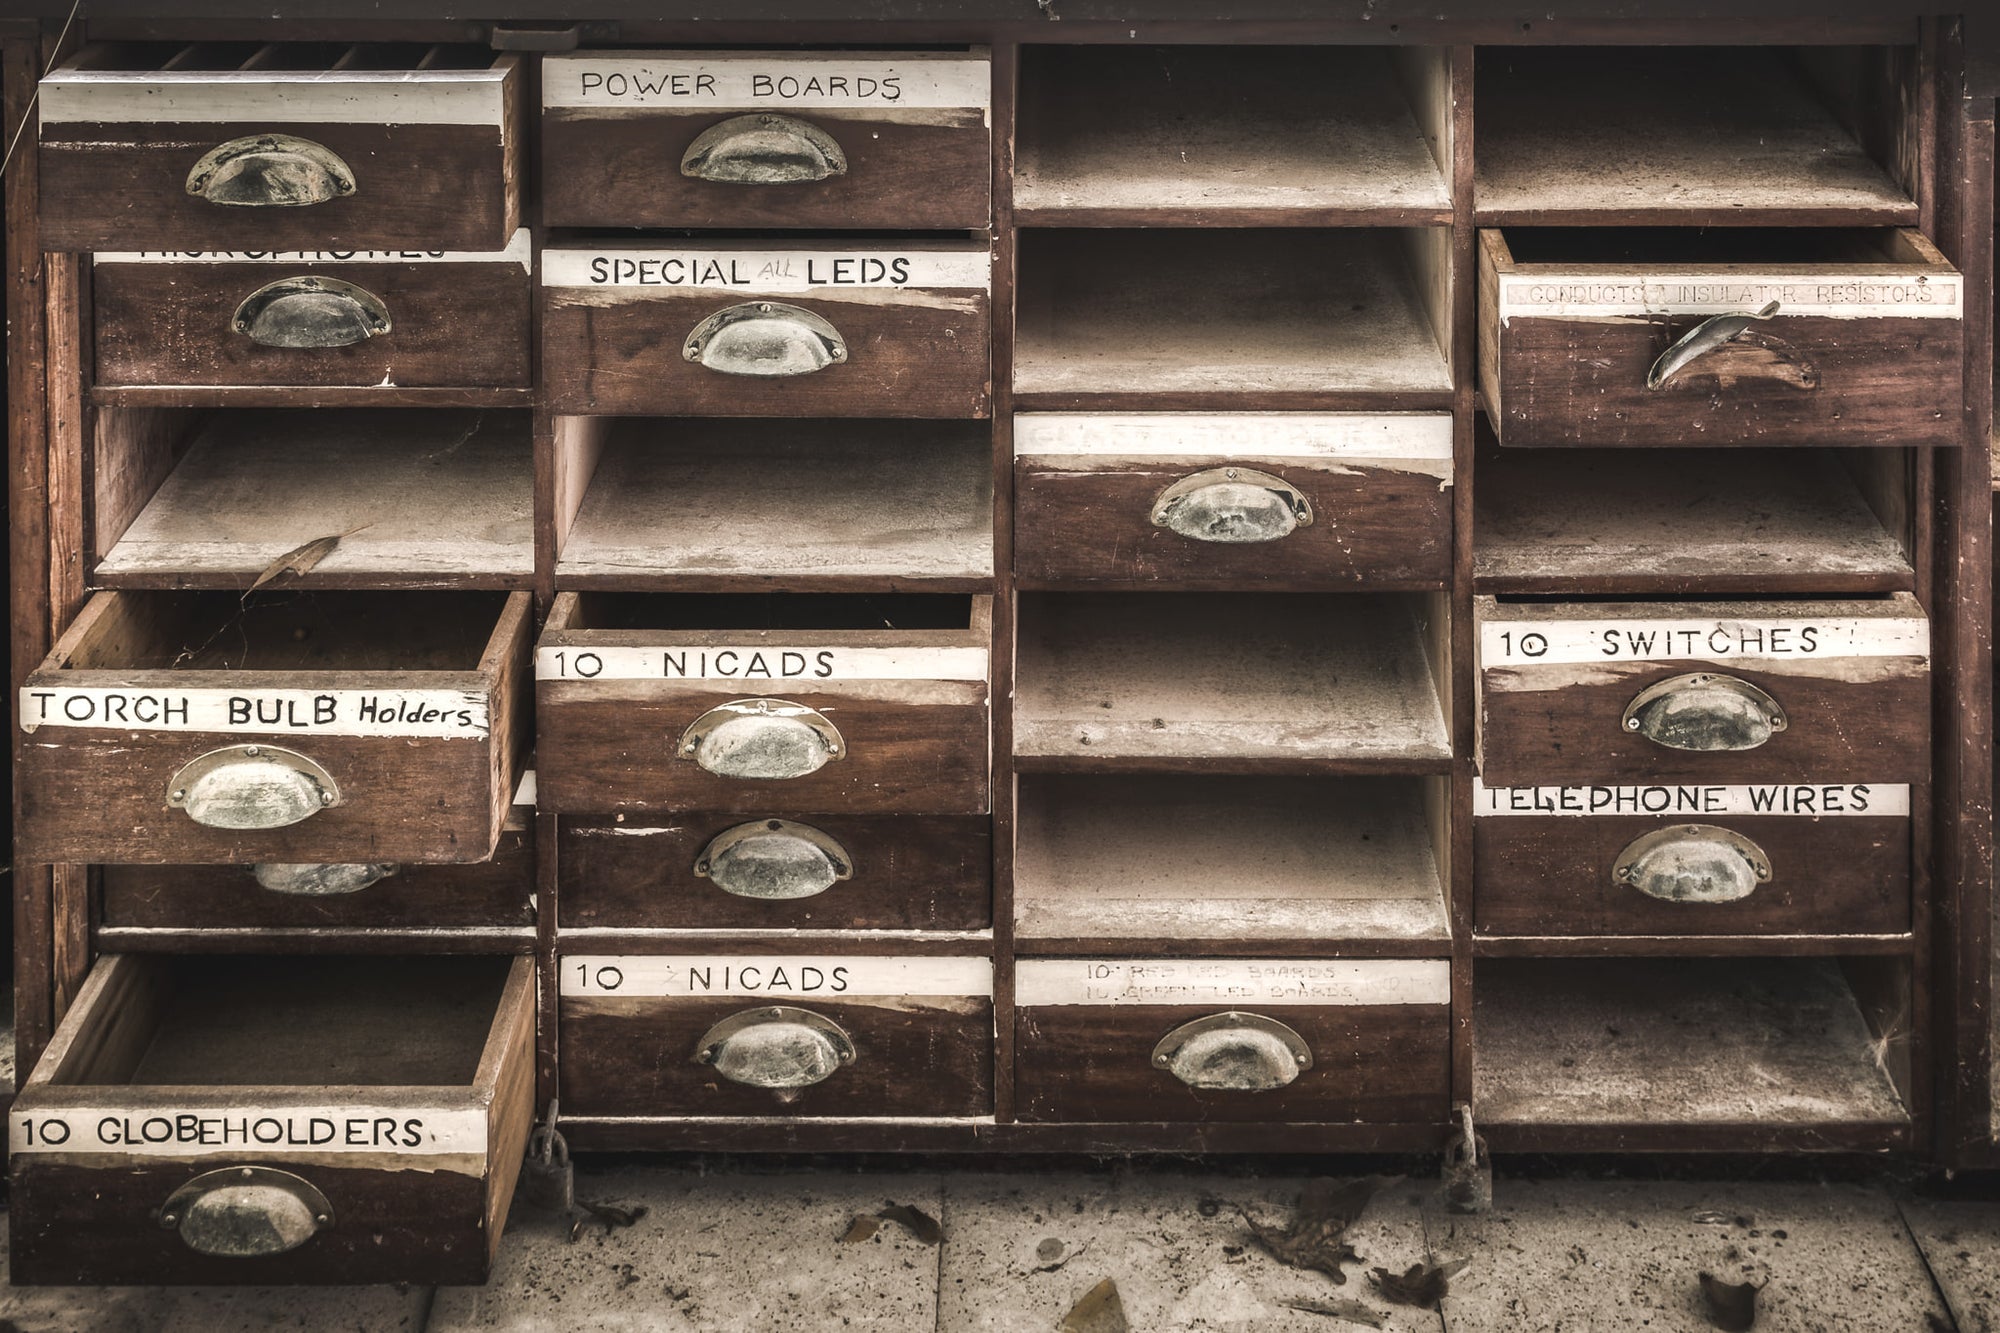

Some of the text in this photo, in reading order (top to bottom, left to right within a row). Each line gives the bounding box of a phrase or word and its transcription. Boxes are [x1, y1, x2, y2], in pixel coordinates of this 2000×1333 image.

[581, 72, 901, 99] POWER BOARDS
[590, 257, 750, 285] SPECIAL
[808, 257, 911, 284] LEDS
[1678, 284, 1797, 303] INSULATOR
[1816, 284, 1933, 303] RESISTORS
[1501, 626, 1818, 656] 10 SWITCHES
[555, 651, 834, 678] 10 NICADS
[30, 693, 472, 727] TORCH BULB Holders
[1483, 785, 1871, 814] TELEPHONE WIRES
[577, 964, 848, 992] 10 NICADS
[21, 1114, 423, 1147] 10 GLOBEHOLDERS
